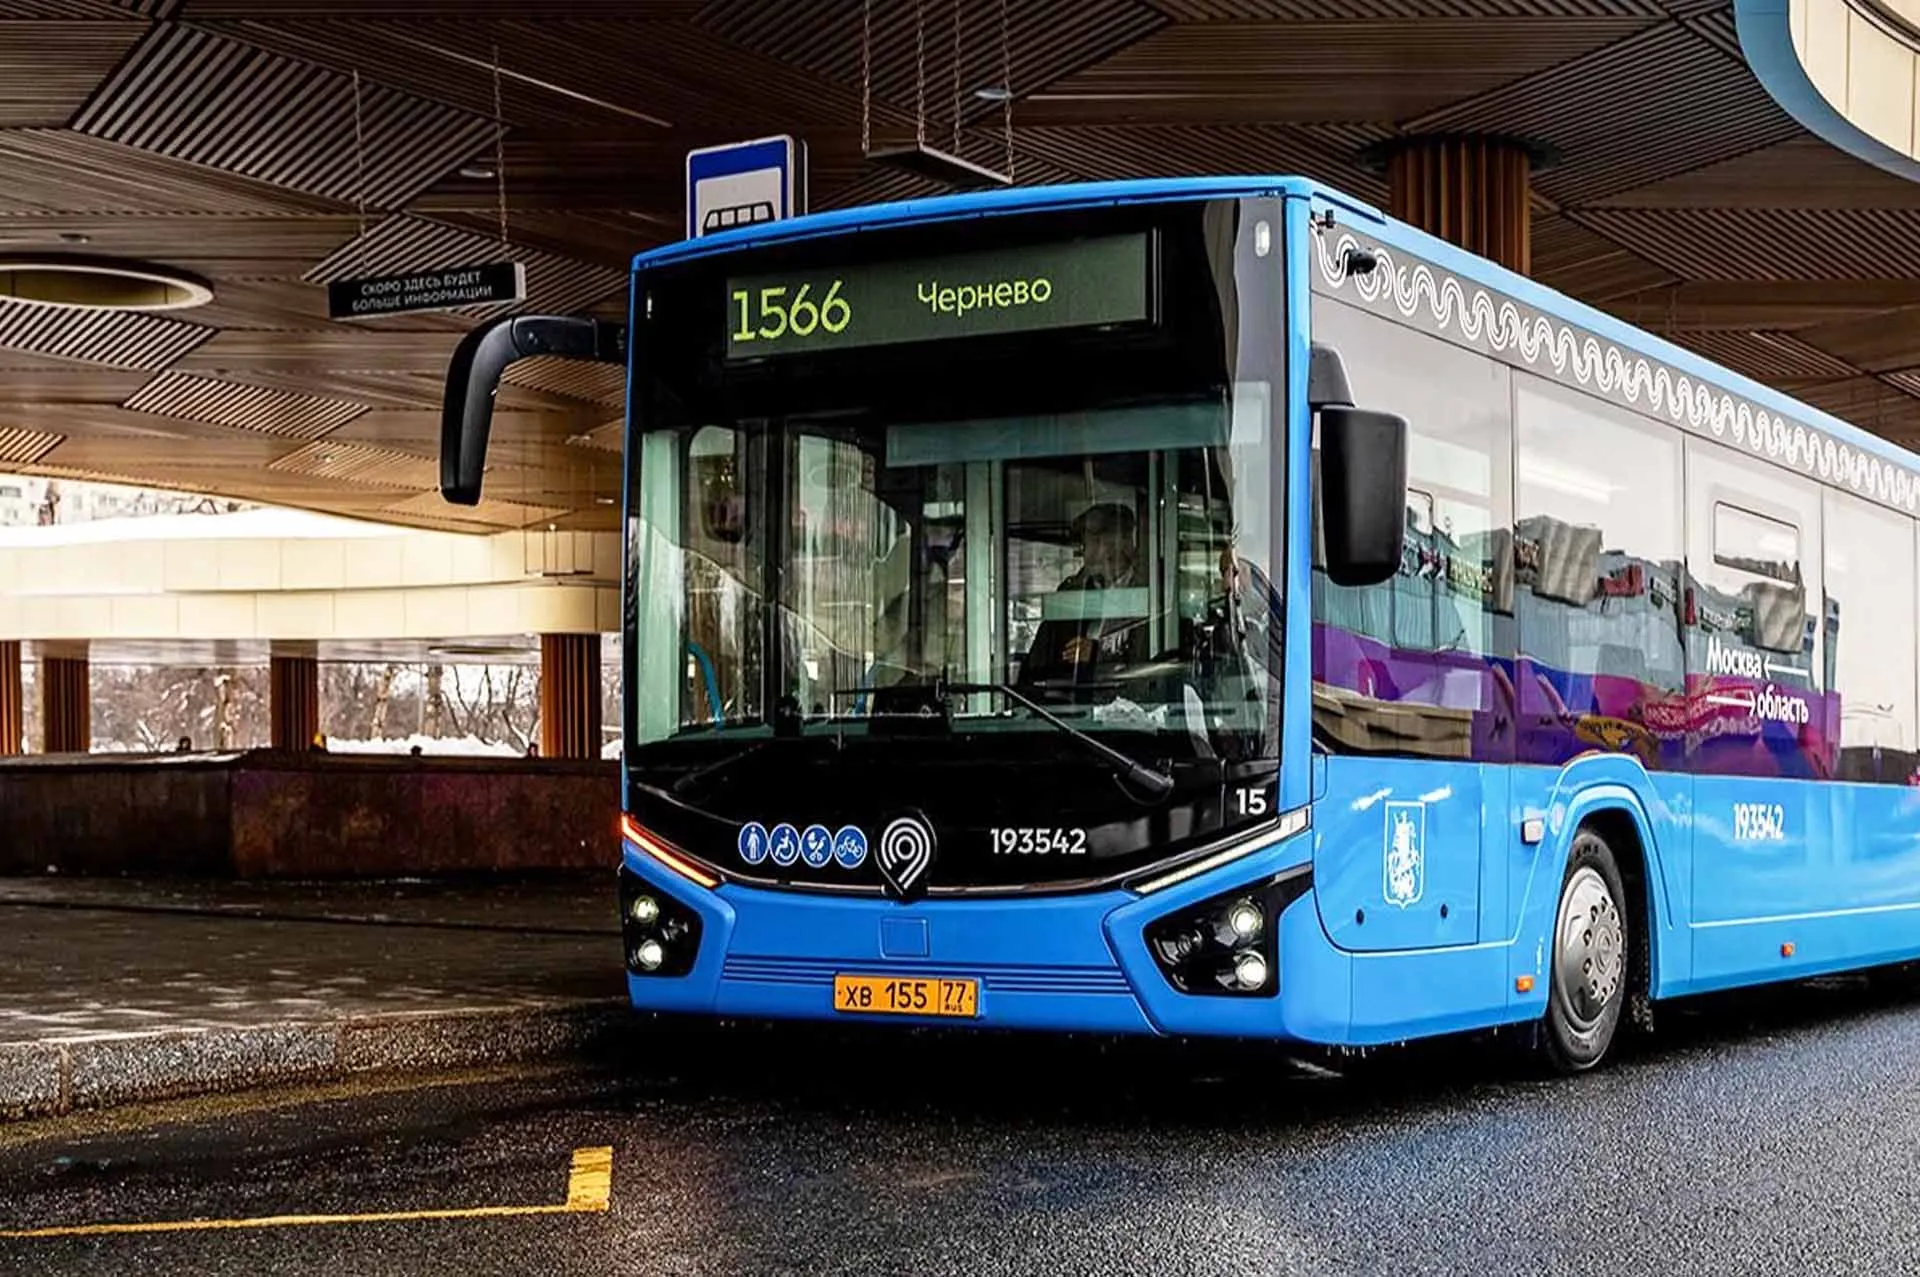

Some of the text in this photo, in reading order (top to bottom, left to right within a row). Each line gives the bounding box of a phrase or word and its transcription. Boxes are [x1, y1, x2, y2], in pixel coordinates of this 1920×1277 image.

[361, 271, 481, 295] СКОРО ЗДЕСЬ БУДЕТ
[352, 285, 492, 312] БОЛЬШЕ ИНФОРМАЦИИ
[732, 277, 1052, 342] 1566 Чернево
[1706, 636, 1762, 679] Москва
[1757, 684, 1809, 724] область
[1235, 788, 1267, 815] 15
[1733, 803, 1784, 840] 193542
[990, 828, 1087, 855] 193542
[885, 982, 927, 1009] 155
[943, 982, 966, 1004] 77
